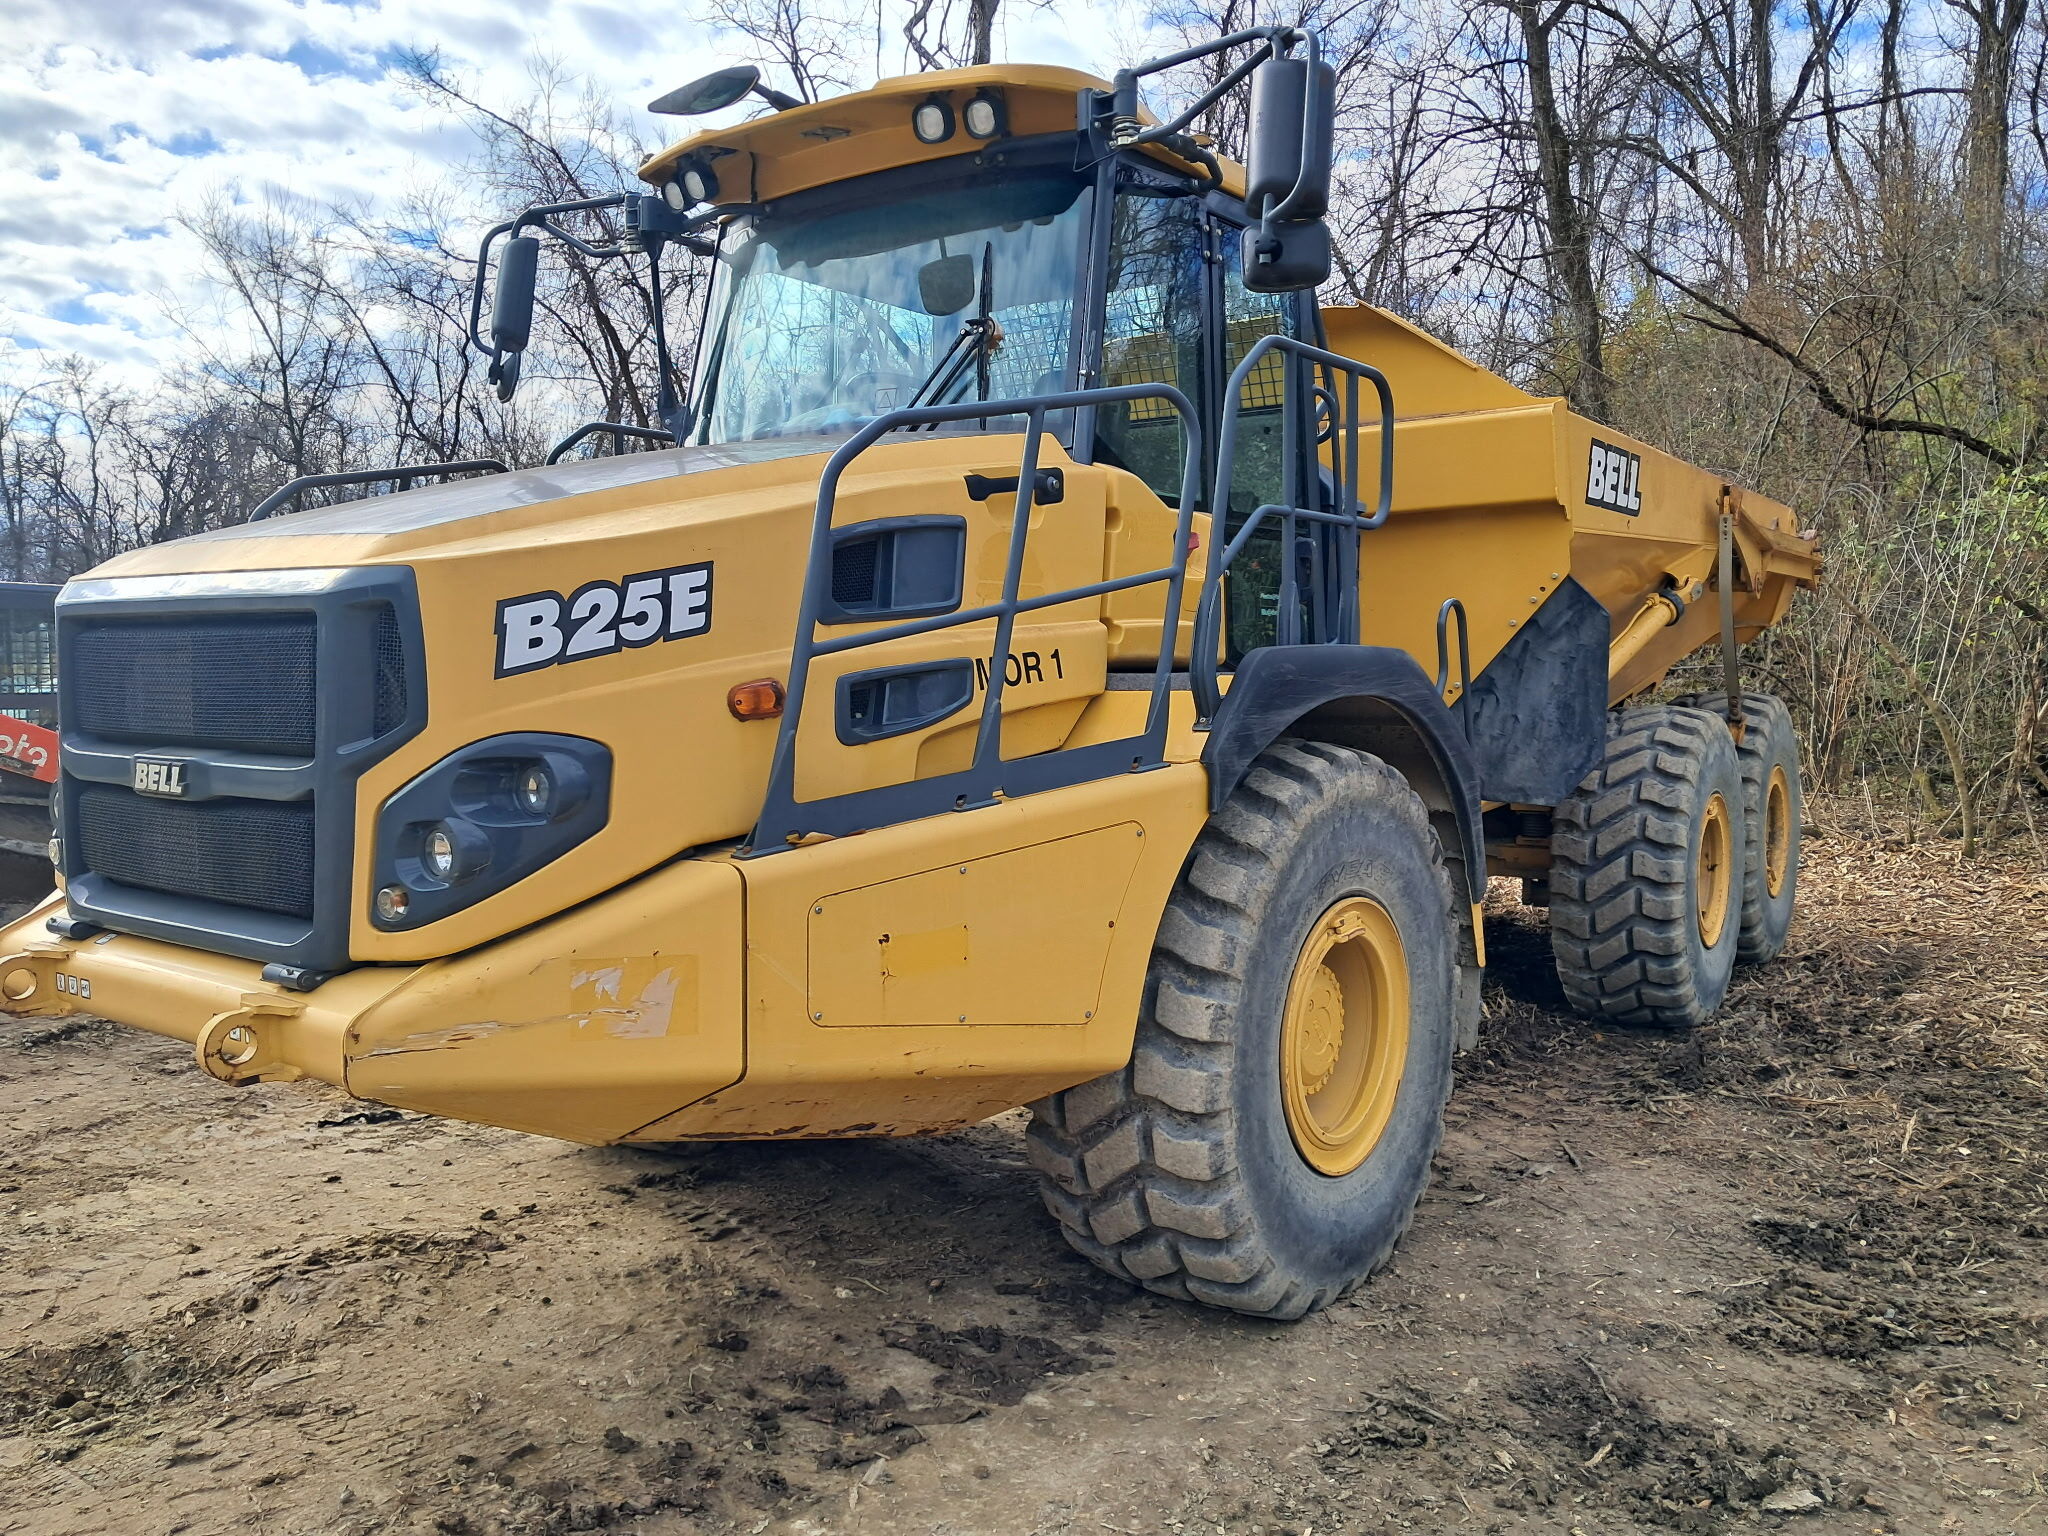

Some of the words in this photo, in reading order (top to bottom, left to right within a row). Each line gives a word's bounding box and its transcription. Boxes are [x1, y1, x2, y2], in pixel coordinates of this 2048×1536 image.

[1587, 445, 1640, 511] BELL
[502, 569, 709, 670] B25E
[1050, 648, 1063, 679] 1
[135, 762, 182, 793] BELL
